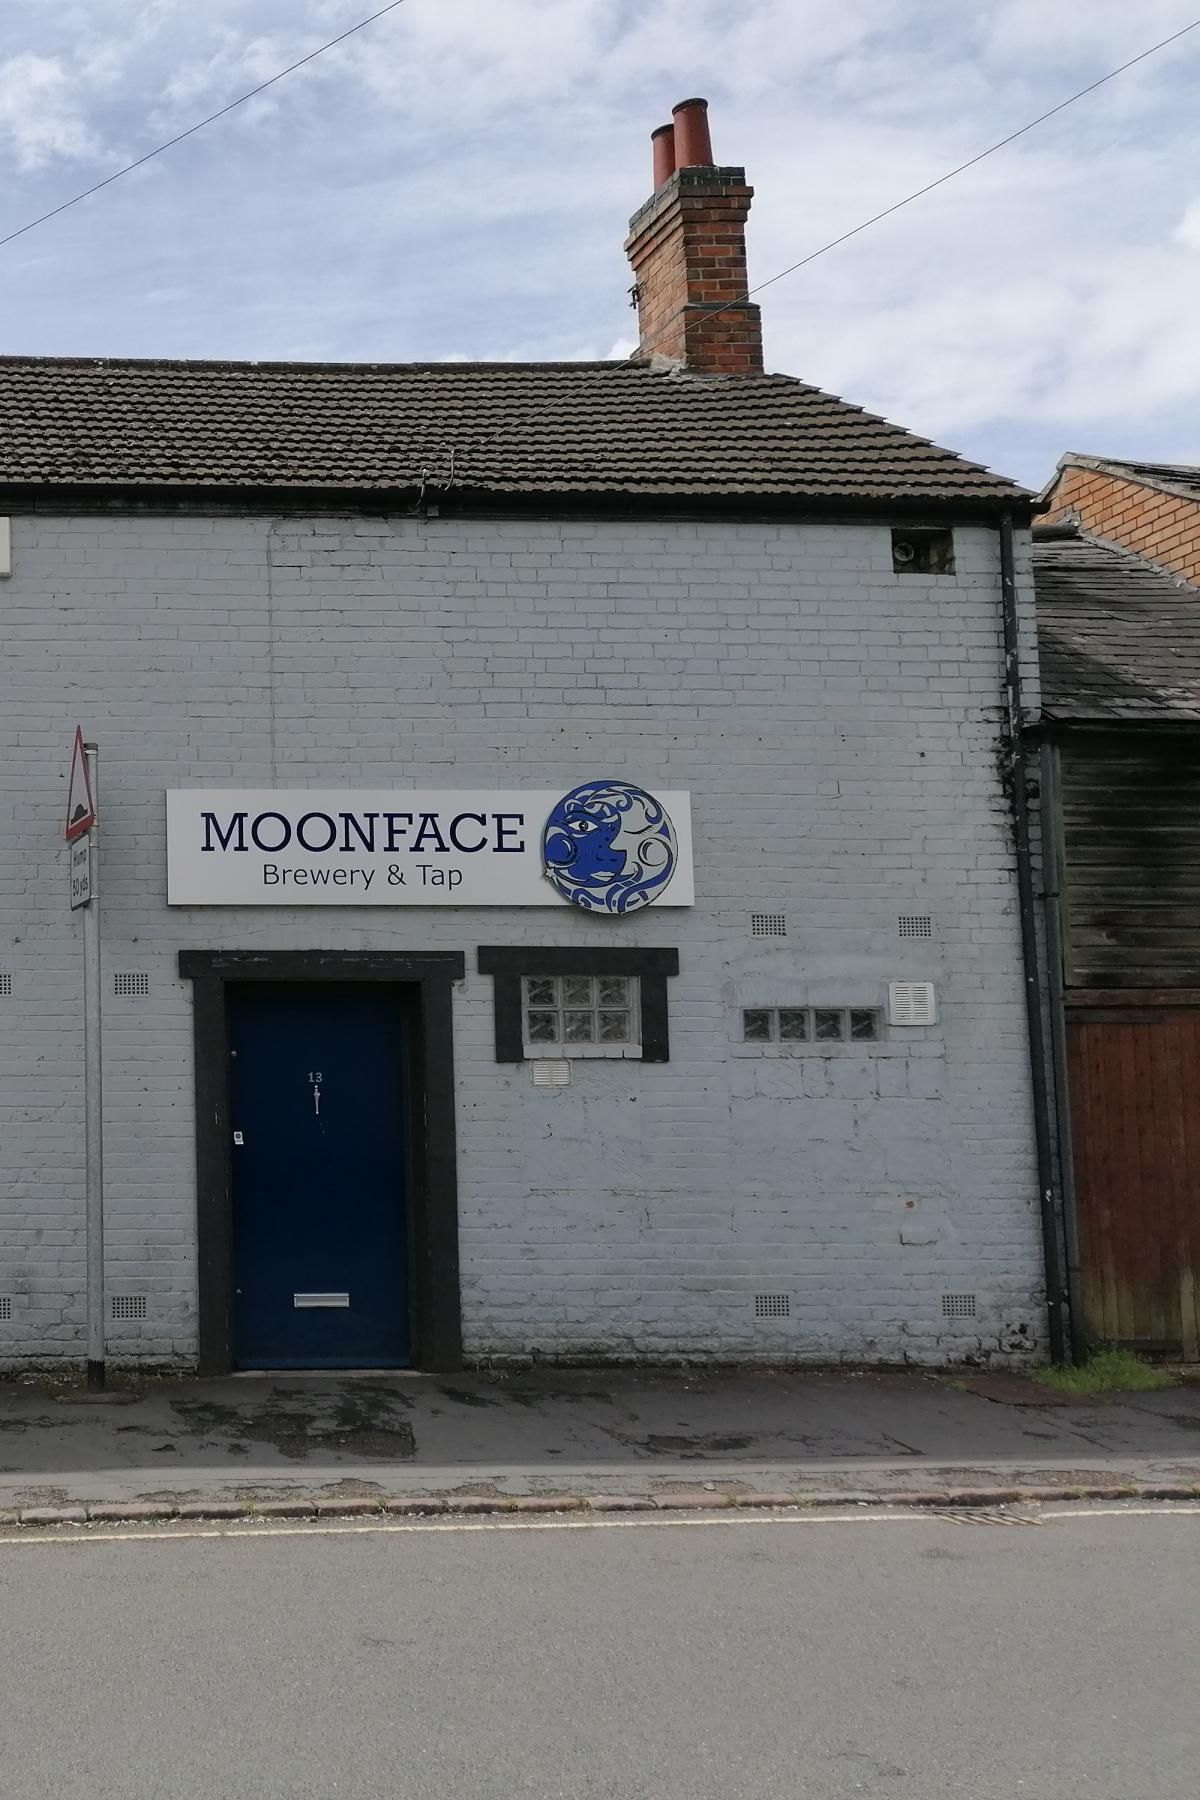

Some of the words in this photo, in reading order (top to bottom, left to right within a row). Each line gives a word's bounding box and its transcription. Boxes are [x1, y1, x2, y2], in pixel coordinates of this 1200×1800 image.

[201, 812, 526, 853] MOONFACE
[73, 877, 80, 897] 50
[264, 864, 376, 890] Brewery
[388, 864, 407, 886] &
[416, 864, 463, 890] Tap
[308, 1072, 323, 1083] 13
